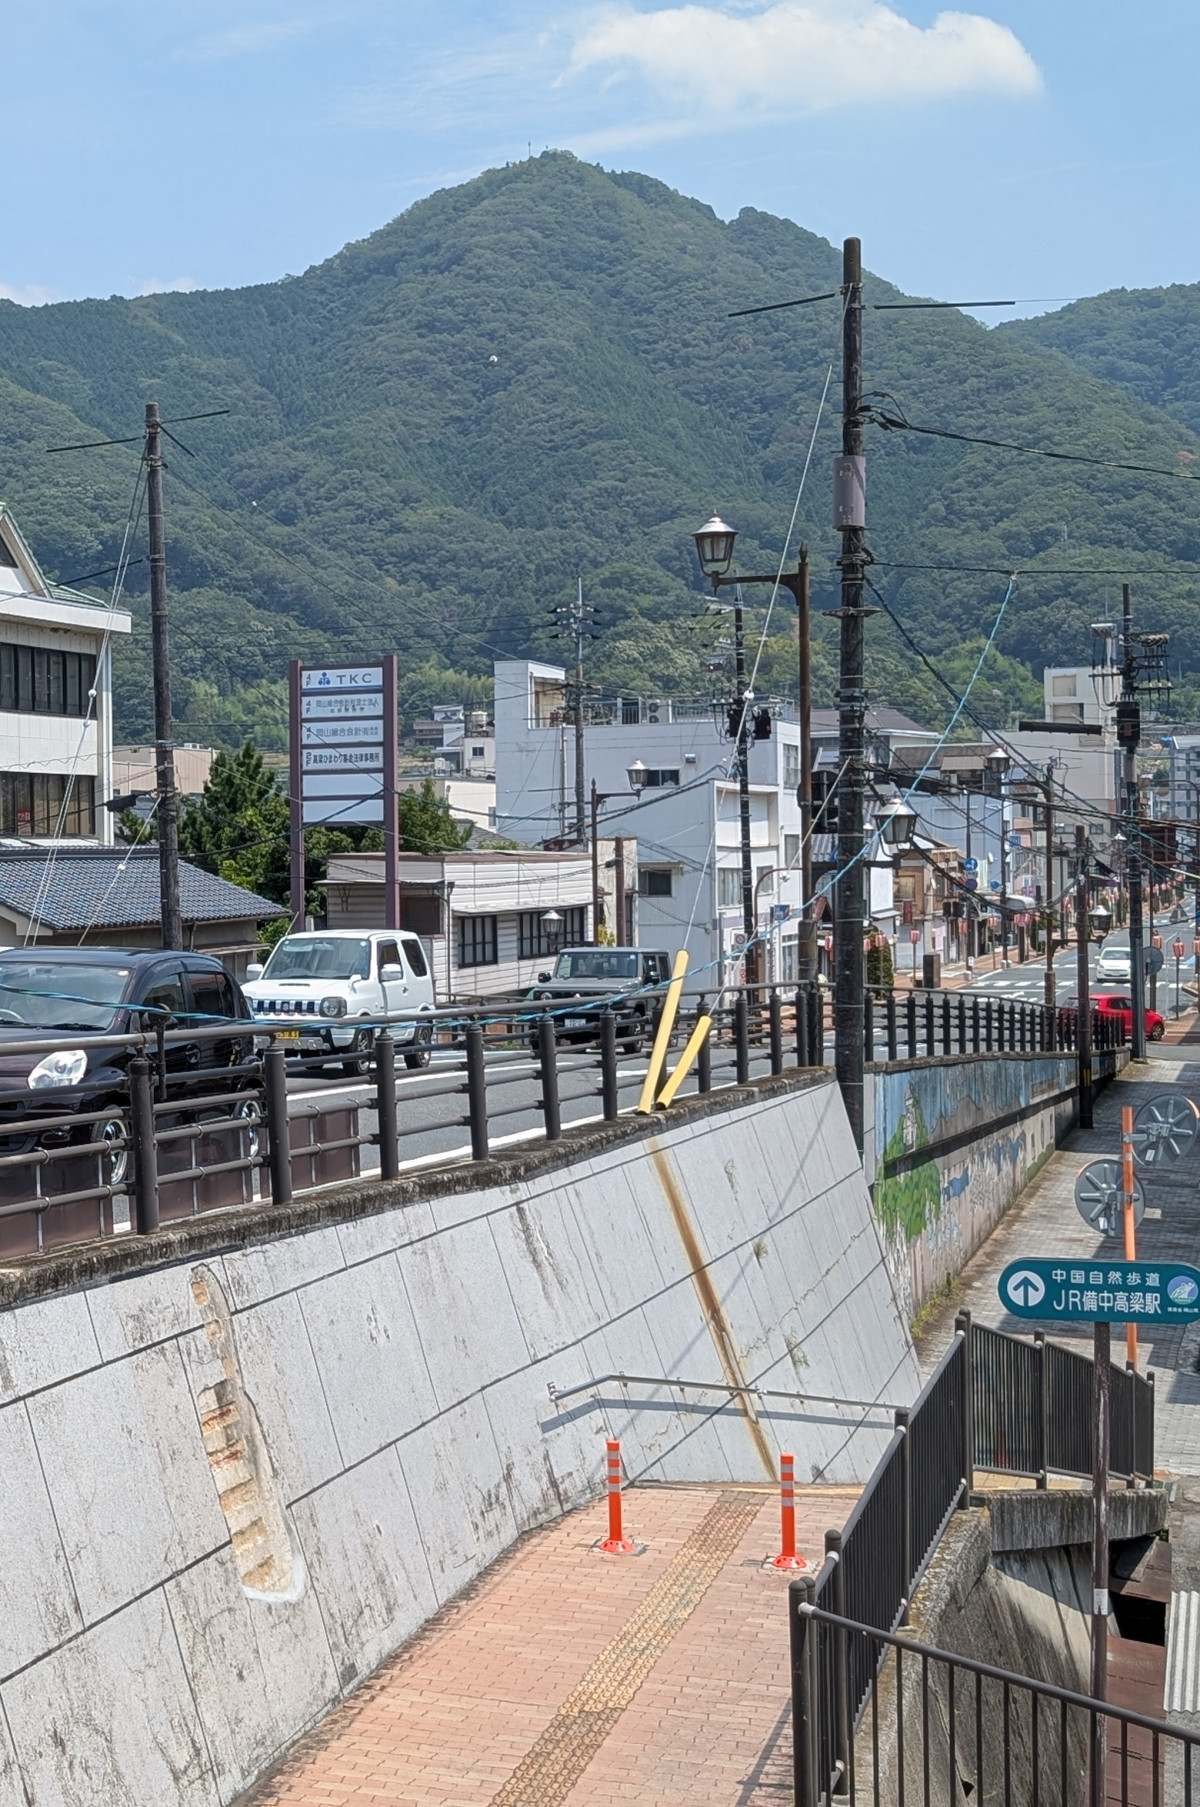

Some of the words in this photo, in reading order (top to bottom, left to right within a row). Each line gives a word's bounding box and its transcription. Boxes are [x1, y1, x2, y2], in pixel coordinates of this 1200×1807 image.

[336, 672, 372, 685] TKC
[1051, 1268, 1161, 1288] 中国自然歩道
[1052, 1289, 1162, 1315] JR備中高梁駅
